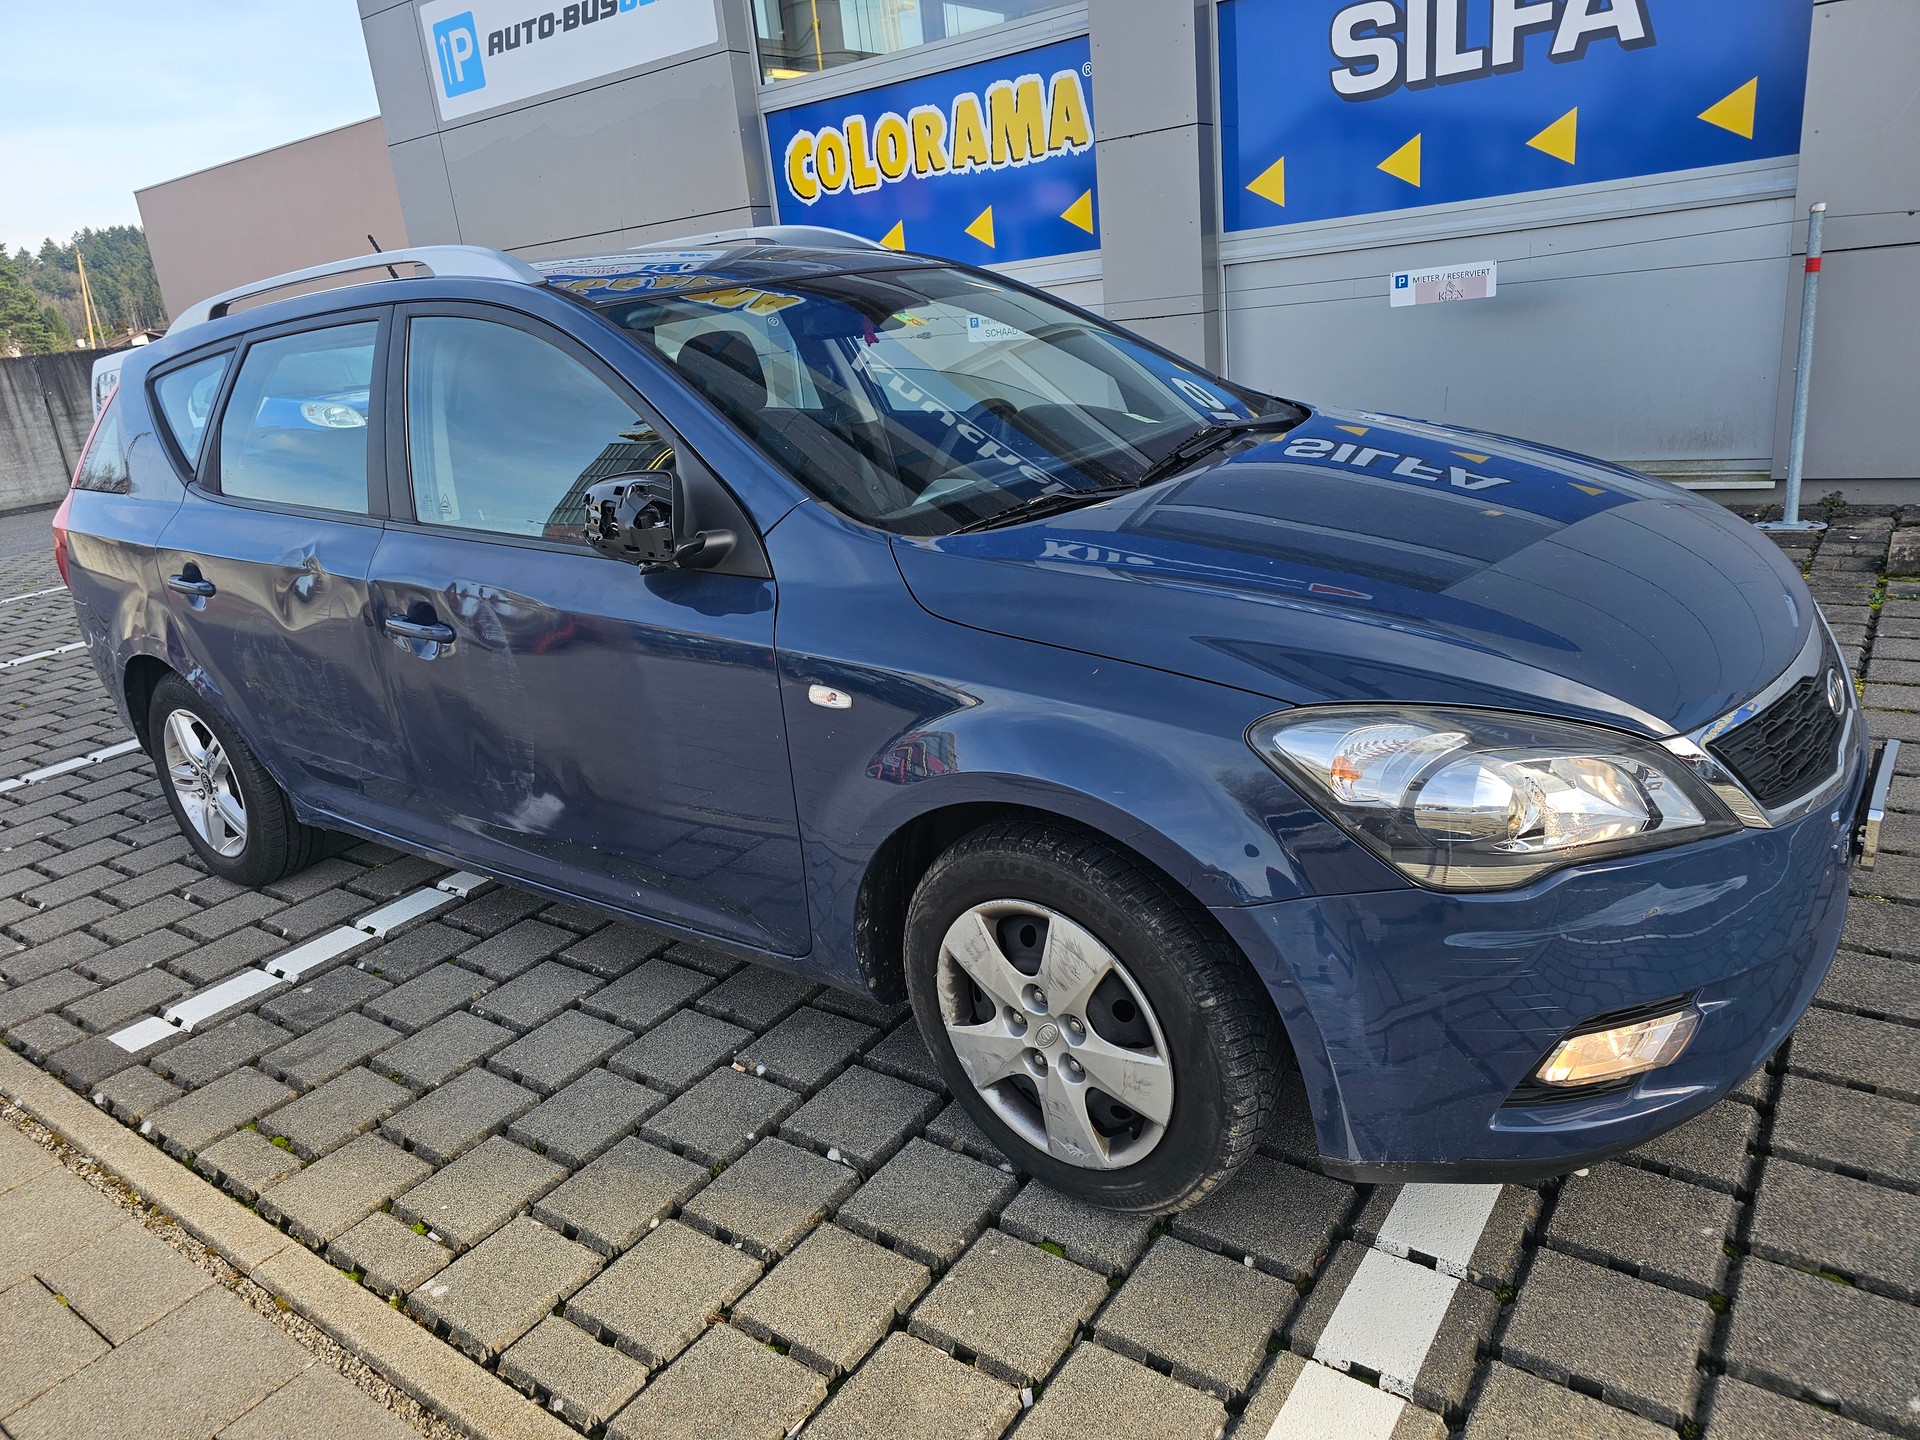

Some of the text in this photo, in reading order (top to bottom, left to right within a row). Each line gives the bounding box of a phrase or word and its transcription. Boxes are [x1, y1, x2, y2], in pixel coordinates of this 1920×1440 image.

[786, 70, 1094, 204] COLORAMA
[1412, 274, 1440, 284] MIETER
[1447, 268, 1491, 280] RESERVIERT
